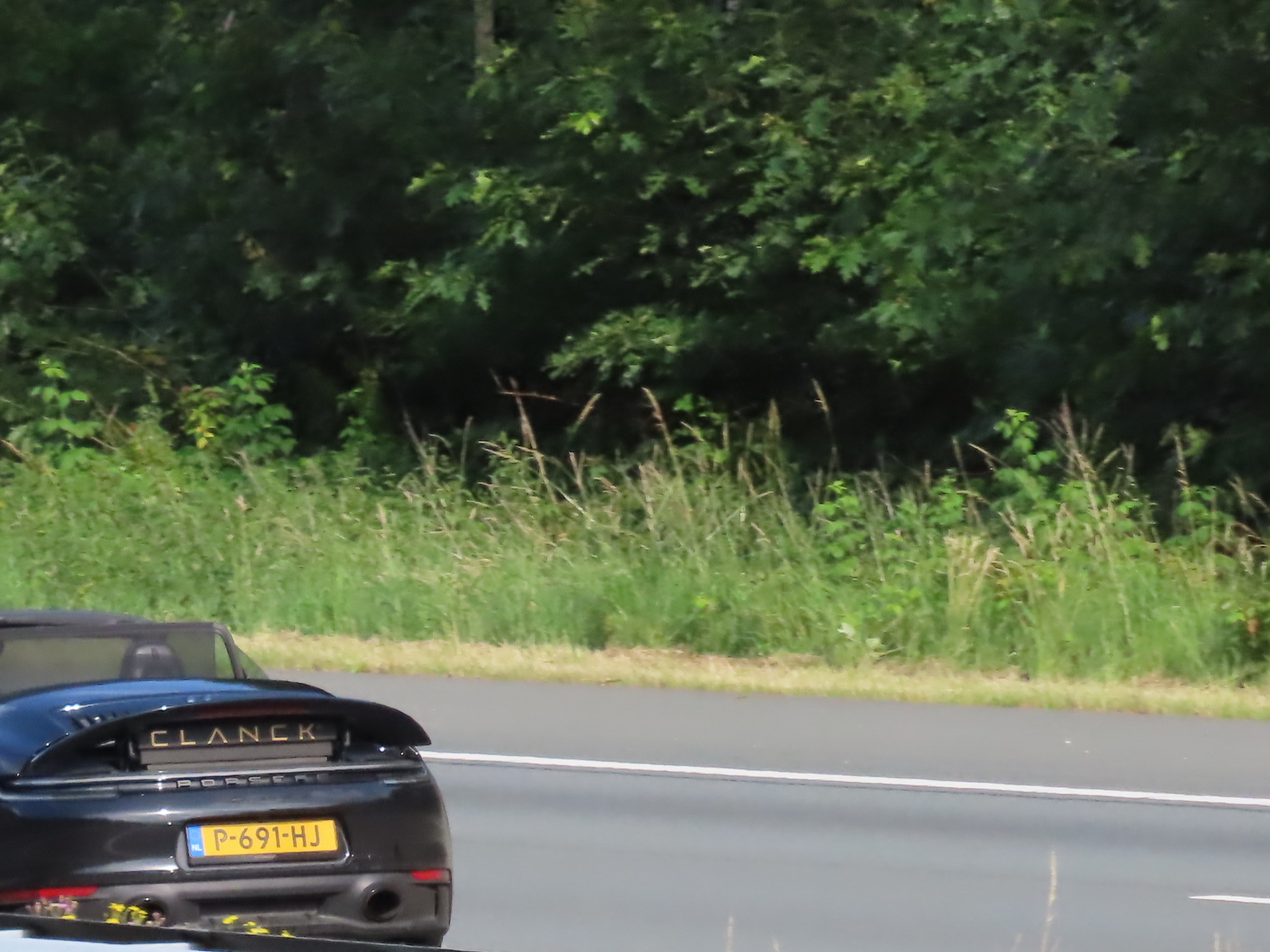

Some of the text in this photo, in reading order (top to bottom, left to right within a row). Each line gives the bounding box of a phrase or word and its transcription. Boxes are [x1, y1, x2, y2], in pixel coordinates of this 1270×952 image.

[150, 724, 317, 747] CLANCK
[177, 774, 331, 789] PORSC
[213, 825, 320, 851] P-691-HJ
